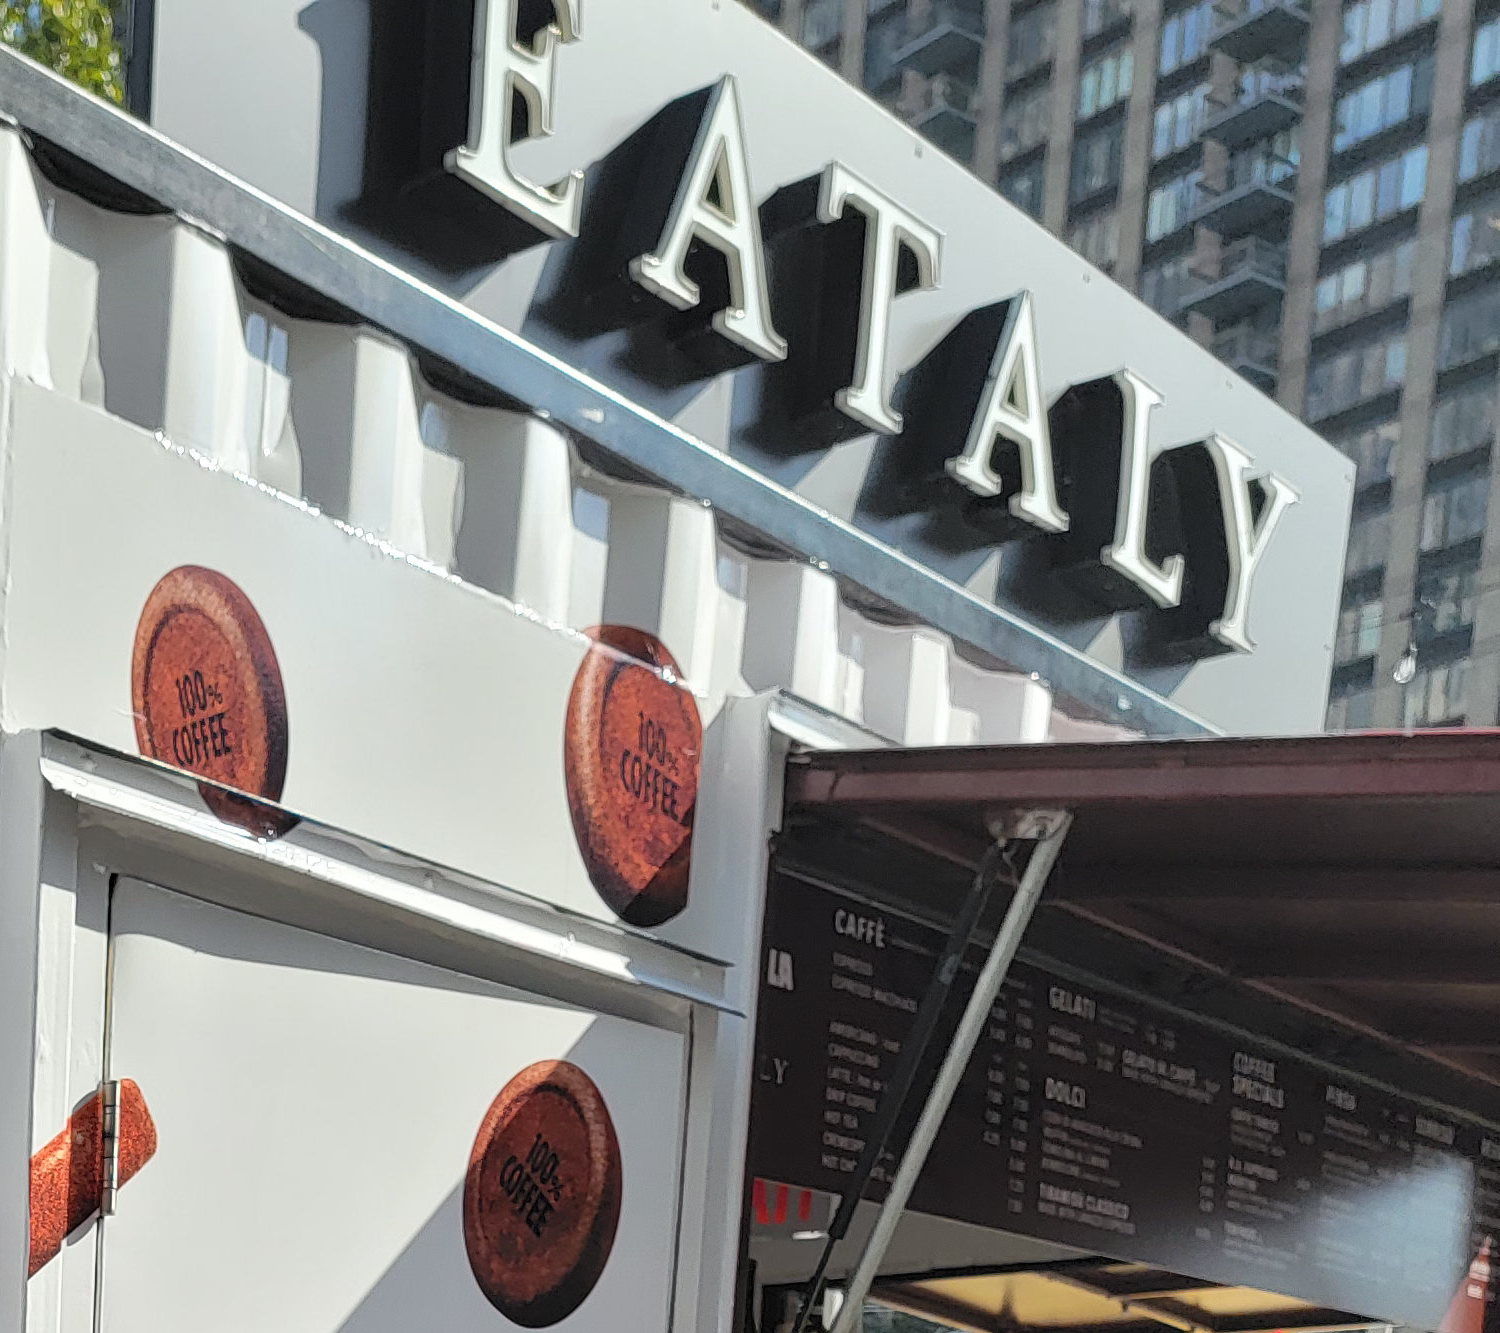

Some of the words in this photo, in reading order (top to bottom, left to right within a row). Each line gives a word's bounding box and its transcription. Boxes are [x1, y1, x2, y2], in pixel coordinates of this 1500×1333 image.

[444, 0, 1299, 653] EATALY
[176, 670, 223, 718] 100%
[173, 712, 231, 767] COFFEE
[638, 711, 678, 776] 100%
[621, 749, 679, 820] COFFEE
[500, 1155, 556, 1237] COFFEE
[527, 1132, 565, 1202] 100%
